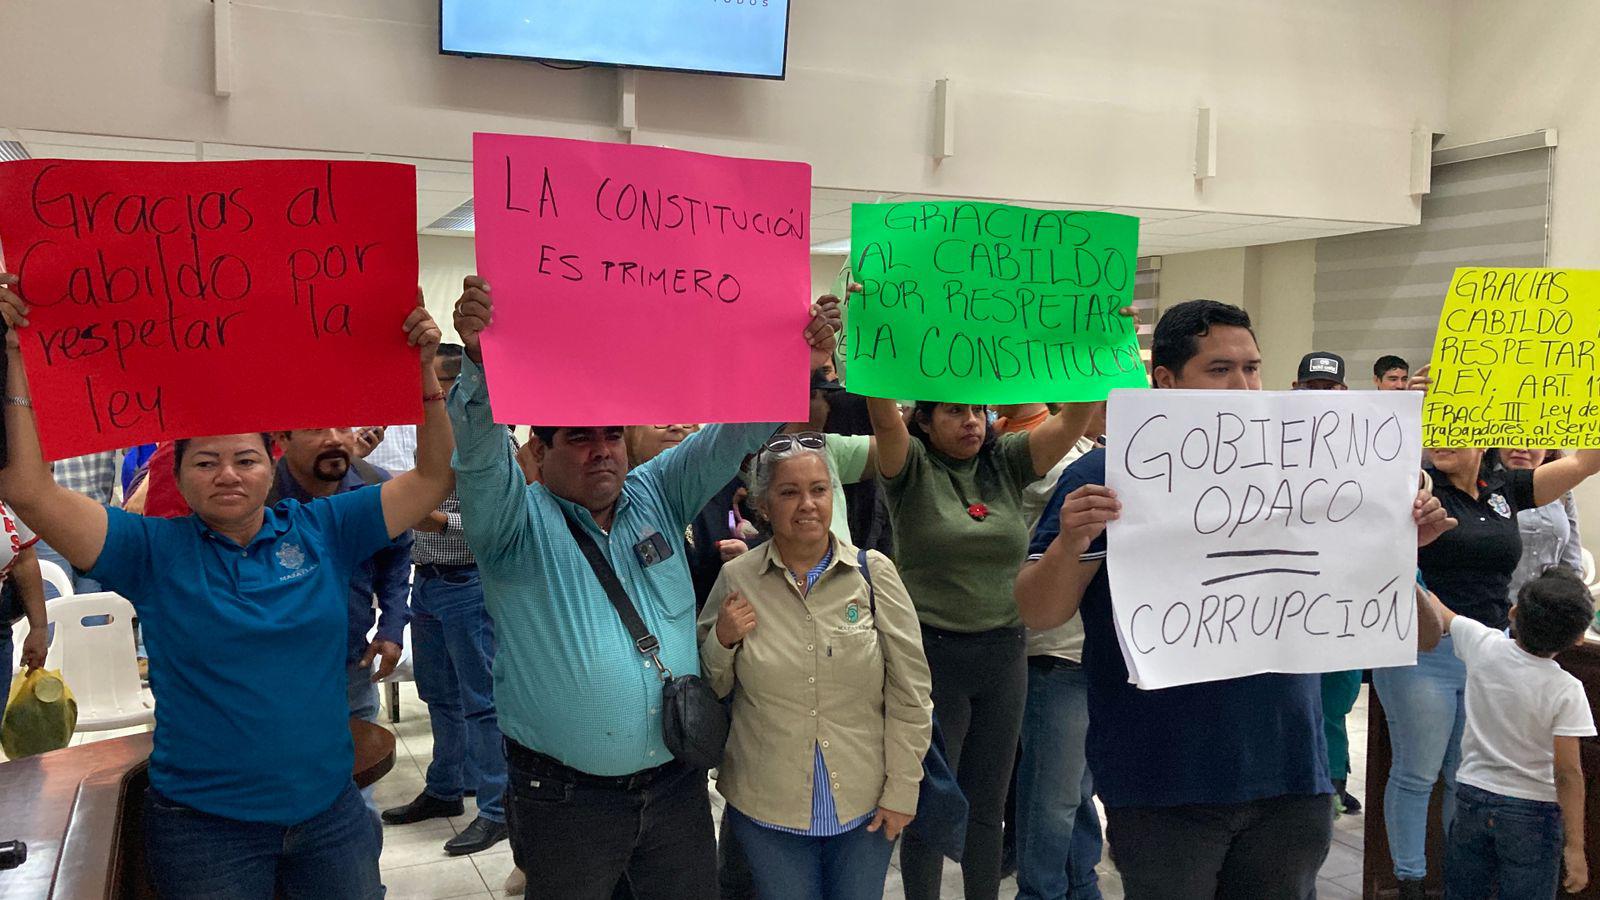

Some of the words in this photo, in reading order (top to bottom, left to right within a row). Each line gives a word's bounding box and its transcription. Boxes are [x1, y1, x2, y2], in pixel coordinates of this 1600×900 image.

[32, 165, 253, 239] Gracias
[287, 163, 337, 227] al
[506, 156, 558, 218] LA
[596, 178, 804, 240] CONSTITUCIÓN
[885, 204, 1091, 246] GRACIAS
[18, 232, 252, 307] Cabildo
[288, 241, 382, 304] por
[538, 245, 583, 282] ES
[601, 261, 741, 303] PRIMERO
[858, 241, 911, 274] AL
[934, 239, 1127, 292] CABILDO
[1456, 270, 1569, 305] GRACIAS
[37, 300, 246, 368] respetar
[309, 284, 352, 339] la
[860, 279, 924, 315] POR
[943, 280, 1124, 334] RESPETAR
[1446, 308, 1573, 335] CABILDO
[854, 324, 896, 360] LA
[1440, 336, 1596, 371] RESPETAR
[86, 375, 165, 433] ley
[1517, 373, 1573, 399] ART.
[1586, 375, 1600, 398] 1
[1540, 402, 1573, 424] Ley
[1578, 400, 1599, 418] de
[1125, 410, 1402, 493] GOBIERNO
[1422, 435, 1440, 447] de
[1447, 436, 1467, 447] los
[1474, 435, 1555, 448] municipios
[1561, 435, 1579, 447] del
[1533, 421, 1550, 436] al
[1194, 478, 1363, 538] OPACO
[1131, 575, 1415, 655] CORRUPCIÓN
